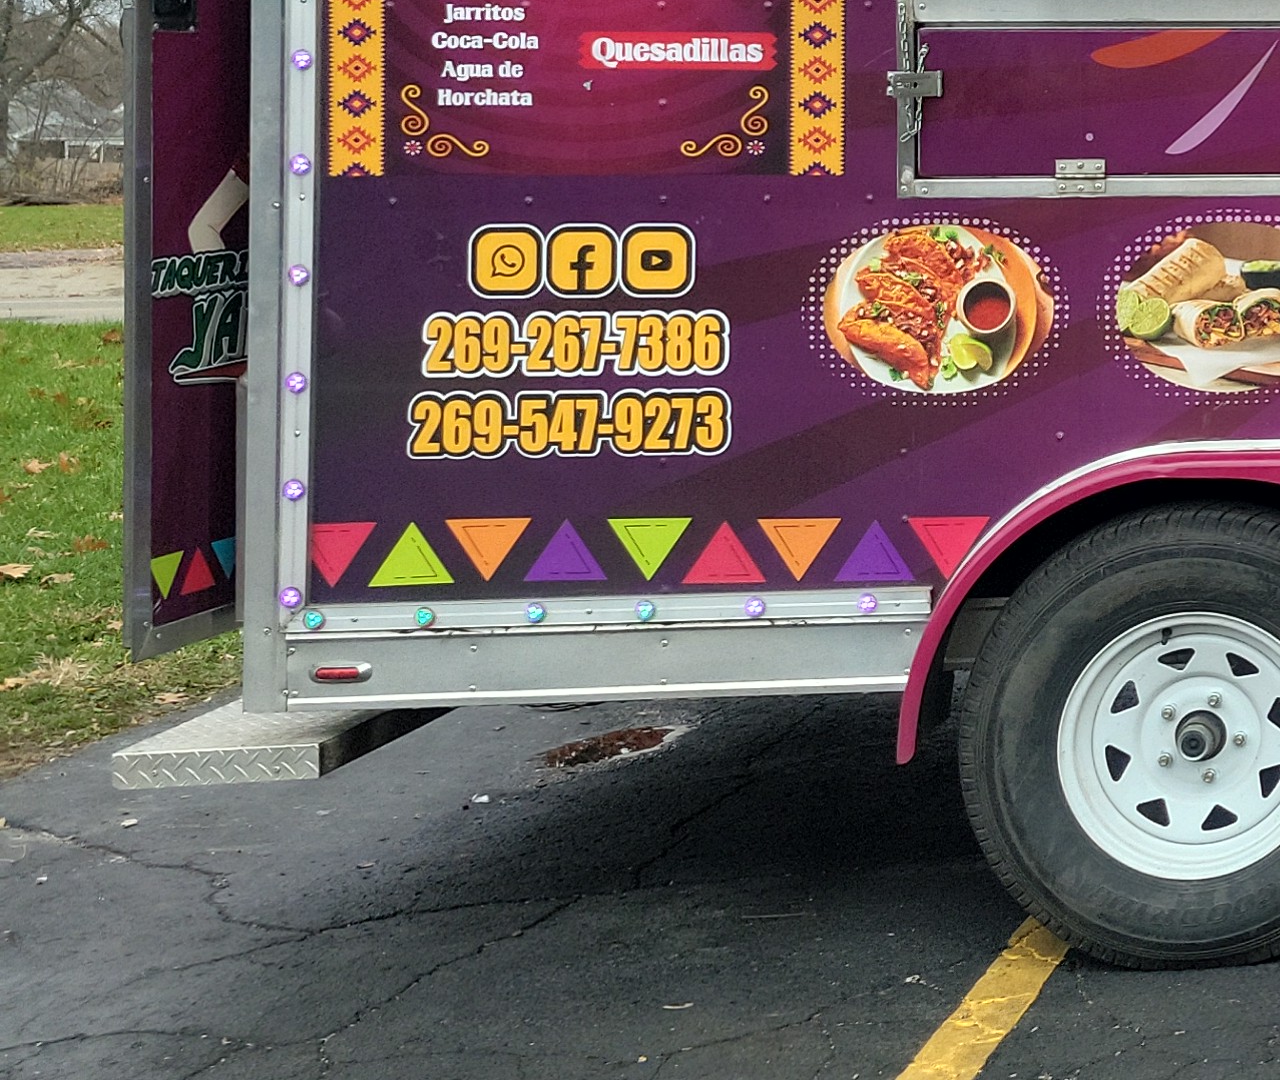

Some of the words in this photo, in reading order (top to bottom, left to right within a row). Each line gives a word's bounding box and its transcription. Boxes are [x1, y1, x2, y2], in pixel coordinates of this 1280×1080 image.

[444, 3, 525, 22] Jarritos
[431, 31, 539, 50] Coca-Cola
[591, 37, 763, 68] Quesadillas
[441, 60, 494, 80] Agua
[498, 59, 524, 78] de
[437, 88, 533, 107] Horchata
[424, 314, 724, 374] 269-267-7386
[411, 395, 726, 456] 269-547-9273
